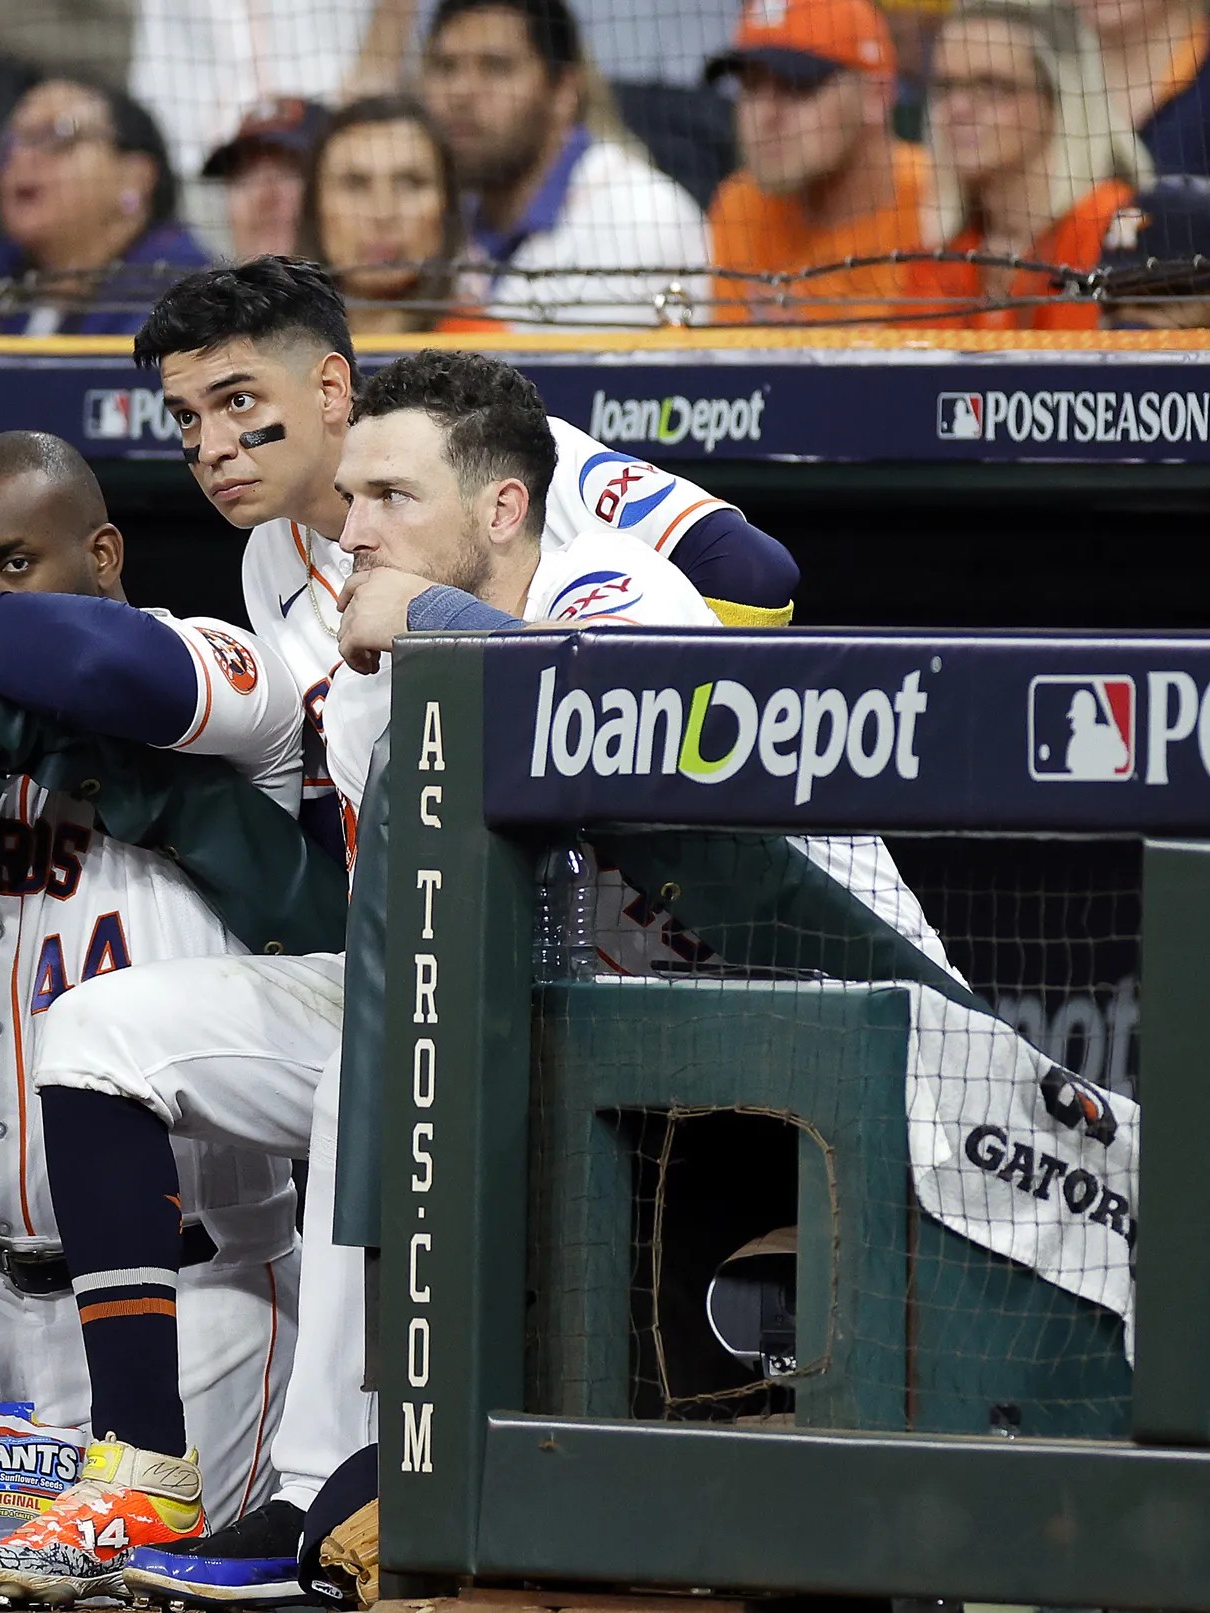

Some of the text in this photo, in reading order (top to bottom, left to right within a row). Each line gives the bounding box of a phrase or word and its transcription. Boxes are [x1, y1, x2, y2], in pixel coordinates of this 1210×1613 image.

[130, 388, 183, 440] PO
[590, 389, 765, 453] loanDepot
[985, 390, 1210, 442] POSTSEASON
[530, 665, 928, 806] loanDepot
[1144, 670, 1210, 785] P
[30, 910, 132, 1016] 44
[964, 1123, 1137, 1250] GATOR
[0, 1473, 64, 1491] Sunflower Seeds
[76, 1517, 130, 1550] 14
